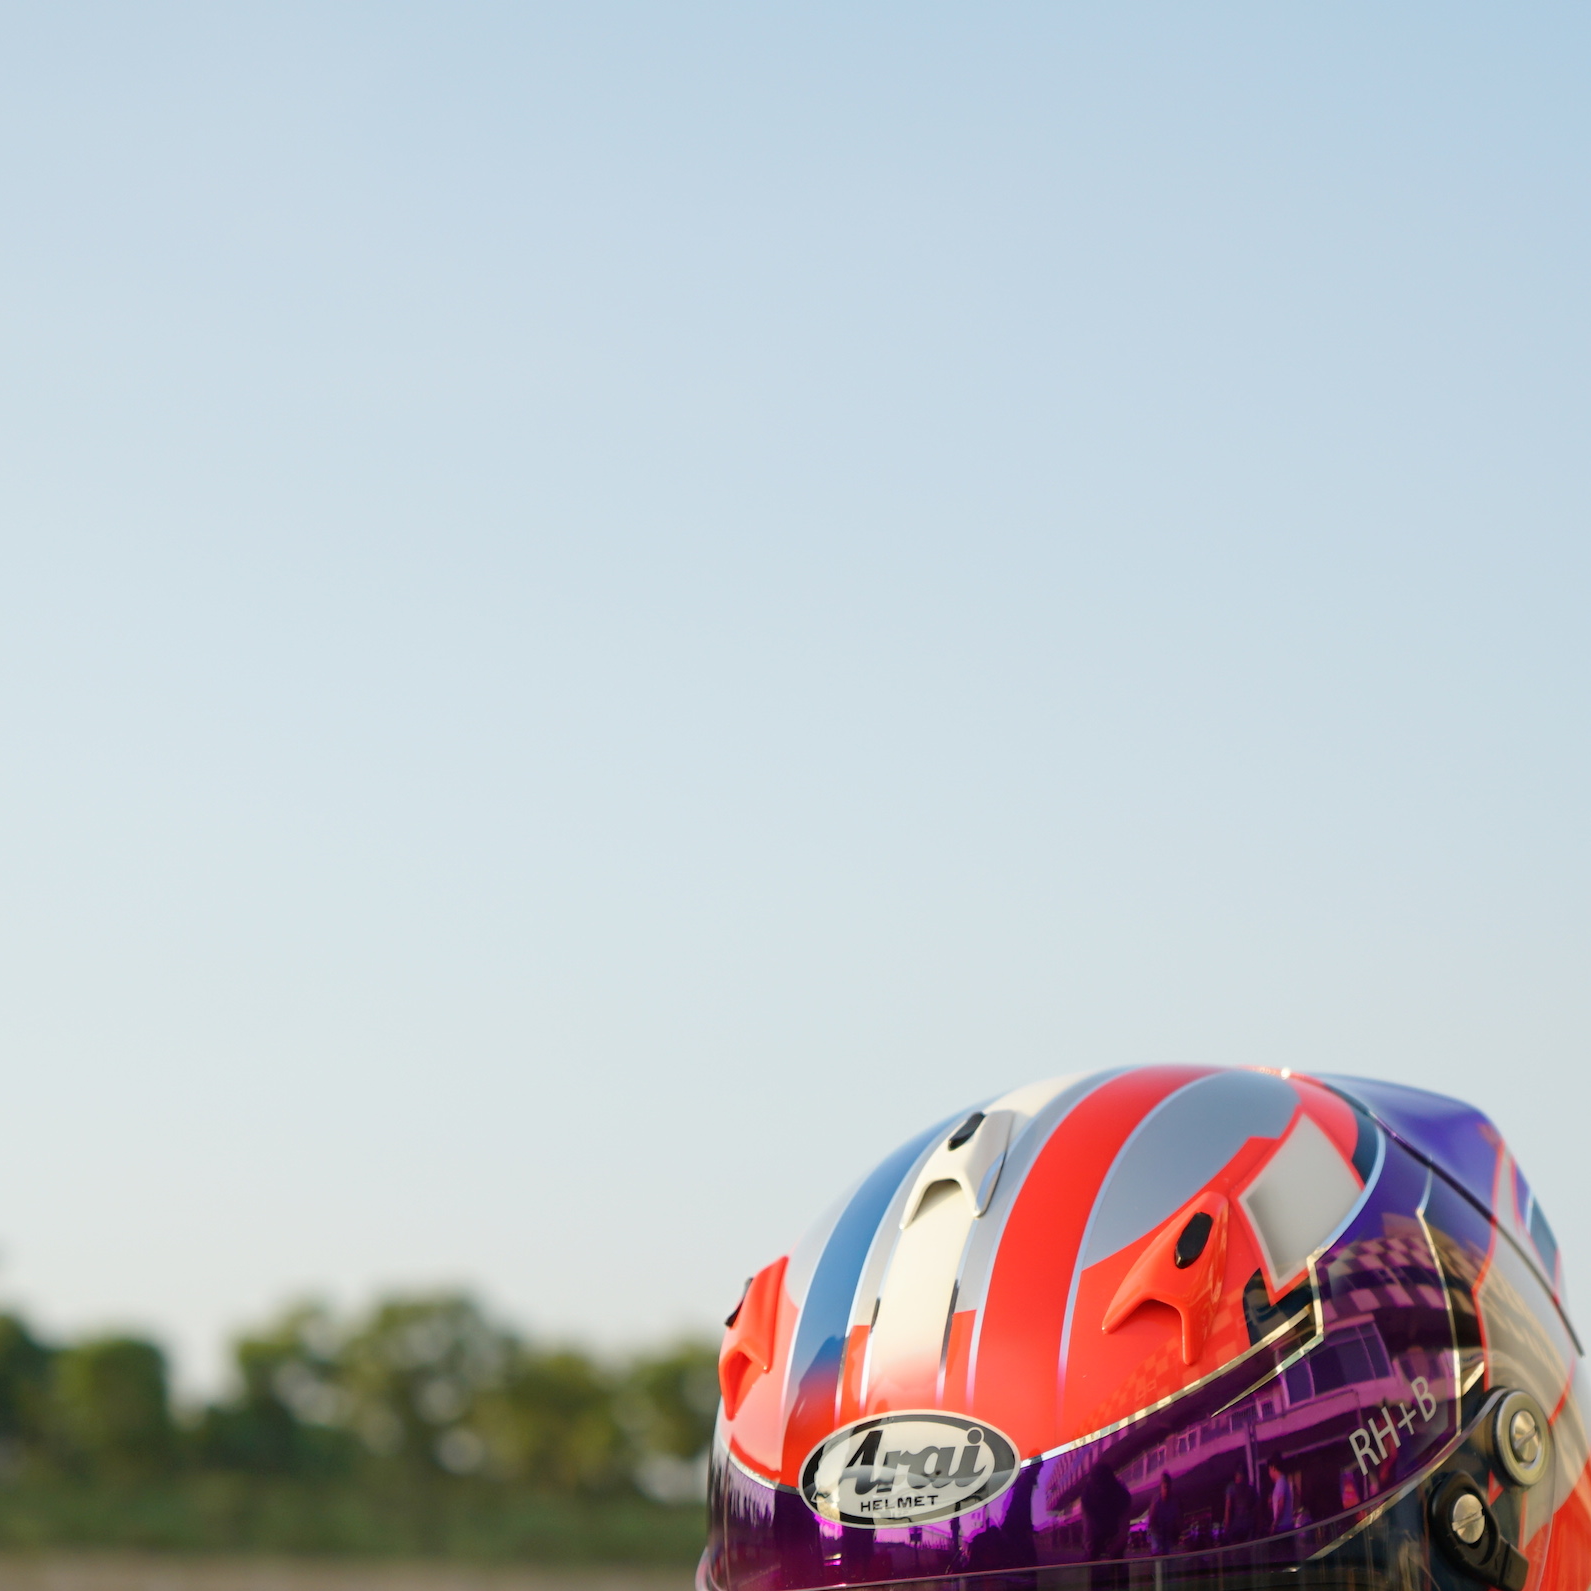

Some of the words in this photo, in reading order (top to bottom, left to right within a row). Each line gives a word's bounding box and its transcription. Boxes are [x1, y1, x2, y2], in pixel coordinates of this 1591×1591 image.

[1349, 1376, 1437, 1476] RH+B
[838, 1427, 987, 1495] Arai
[860, 1495, 939, 1513] HELMET
